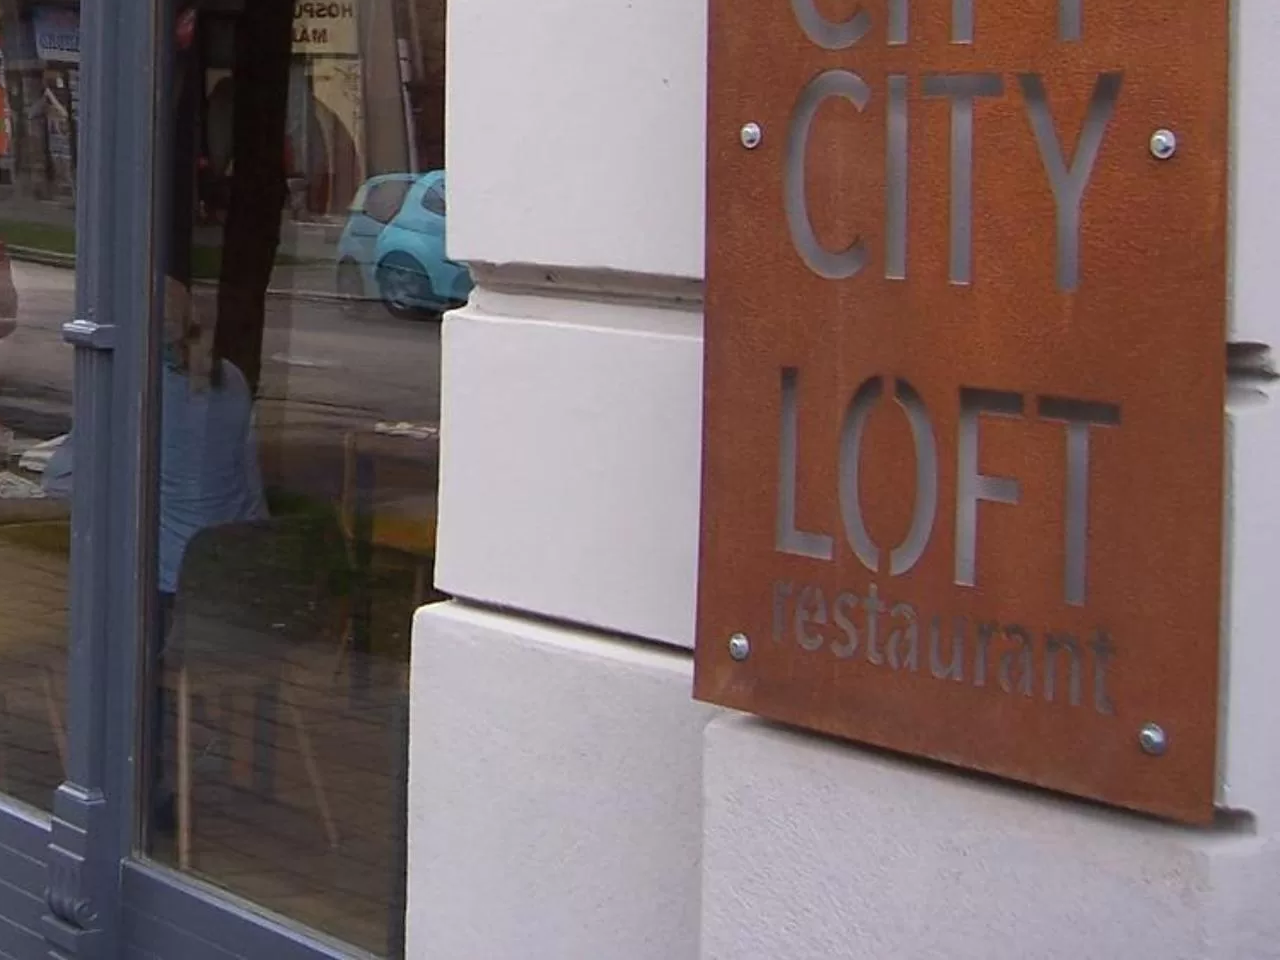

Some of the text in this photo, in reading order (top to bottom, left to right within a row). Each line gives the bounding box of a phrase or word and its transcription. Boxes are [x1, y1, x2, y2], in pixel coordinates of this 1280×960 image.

[783, 68, 1121, 292] CITY
[775, 365, 1120, 607] LOFT
[771, 579, 1117, 716] restaurant
